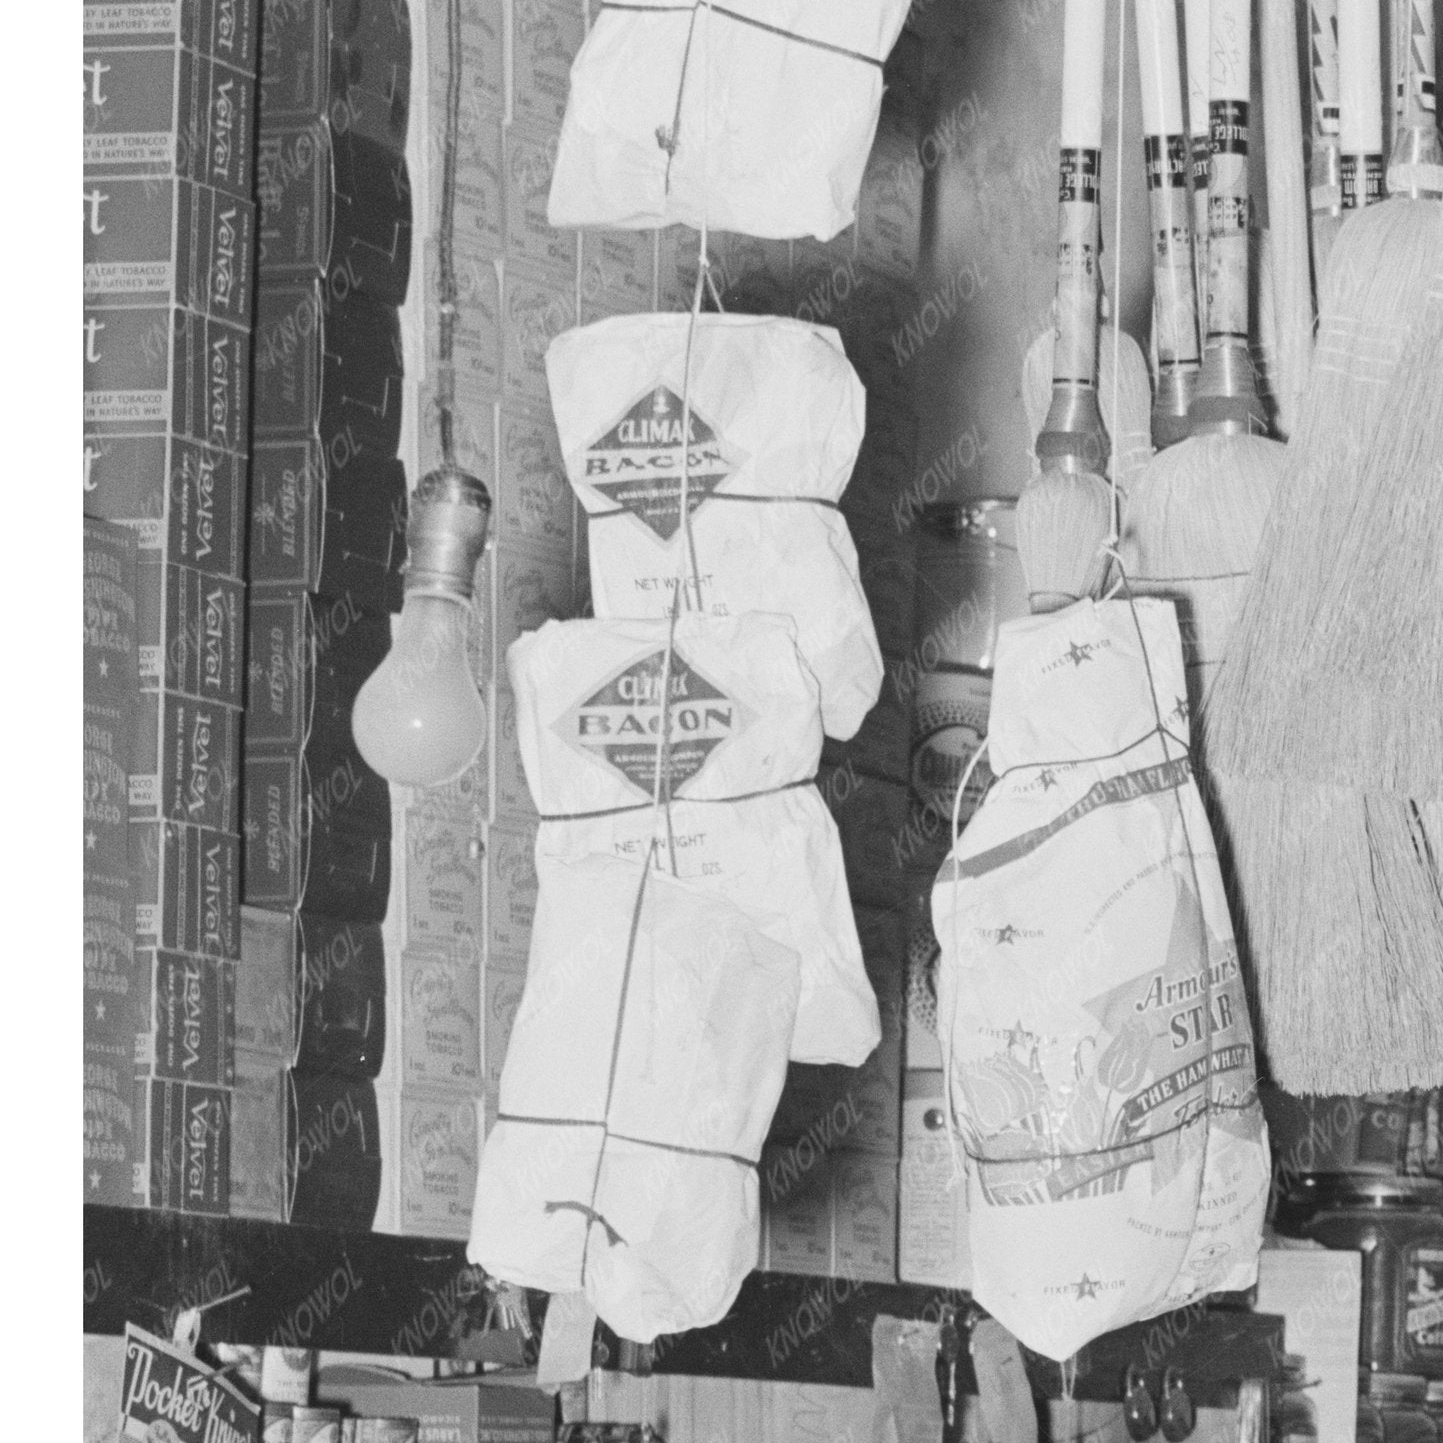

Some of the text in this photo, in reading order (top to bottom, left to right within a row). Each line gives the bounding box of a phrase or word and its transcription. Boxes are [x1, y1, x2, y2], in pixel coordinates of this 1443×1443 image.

[101, 6, 172, 19] LEAF TOBACCO
[152, 17, 172, 29] WAY
[97, 136, 168, 149] LEAF TOBACCO
[212, 77, 234, 182] Velvet
[214, 207, 237, 309] Velvet
[92, 393, 163, 407] LEAF TOBACCO
[211, 335, 232, 436] Velvet
[584, 446, 730, 477] BACON
[618, 418, 696, 443] CLIMAX
[196, 454, 215, 562] Velvet
[282, 468, 296, 558] BLENDED
[634, 577, 659, 591] NET
[204, 587, 223, 690] Velvet
[578, 706, 733, 737] BACON
[191, 713, 211, 816] Velvet
[204, 842, 222, 949] Velvet
[182, 962, 203, 1072] Velvet
[1135, 951, 1239, 1012] Armour's
[1169, 992, 1234, 1051] STAR
[1137, 1076, 1173, 1112] THE
[1176, 1061, 1208, 1091] HAM
[189, 1098, 208, 1201] Velvet
[127, 1342, 203, 1433] Pocket
